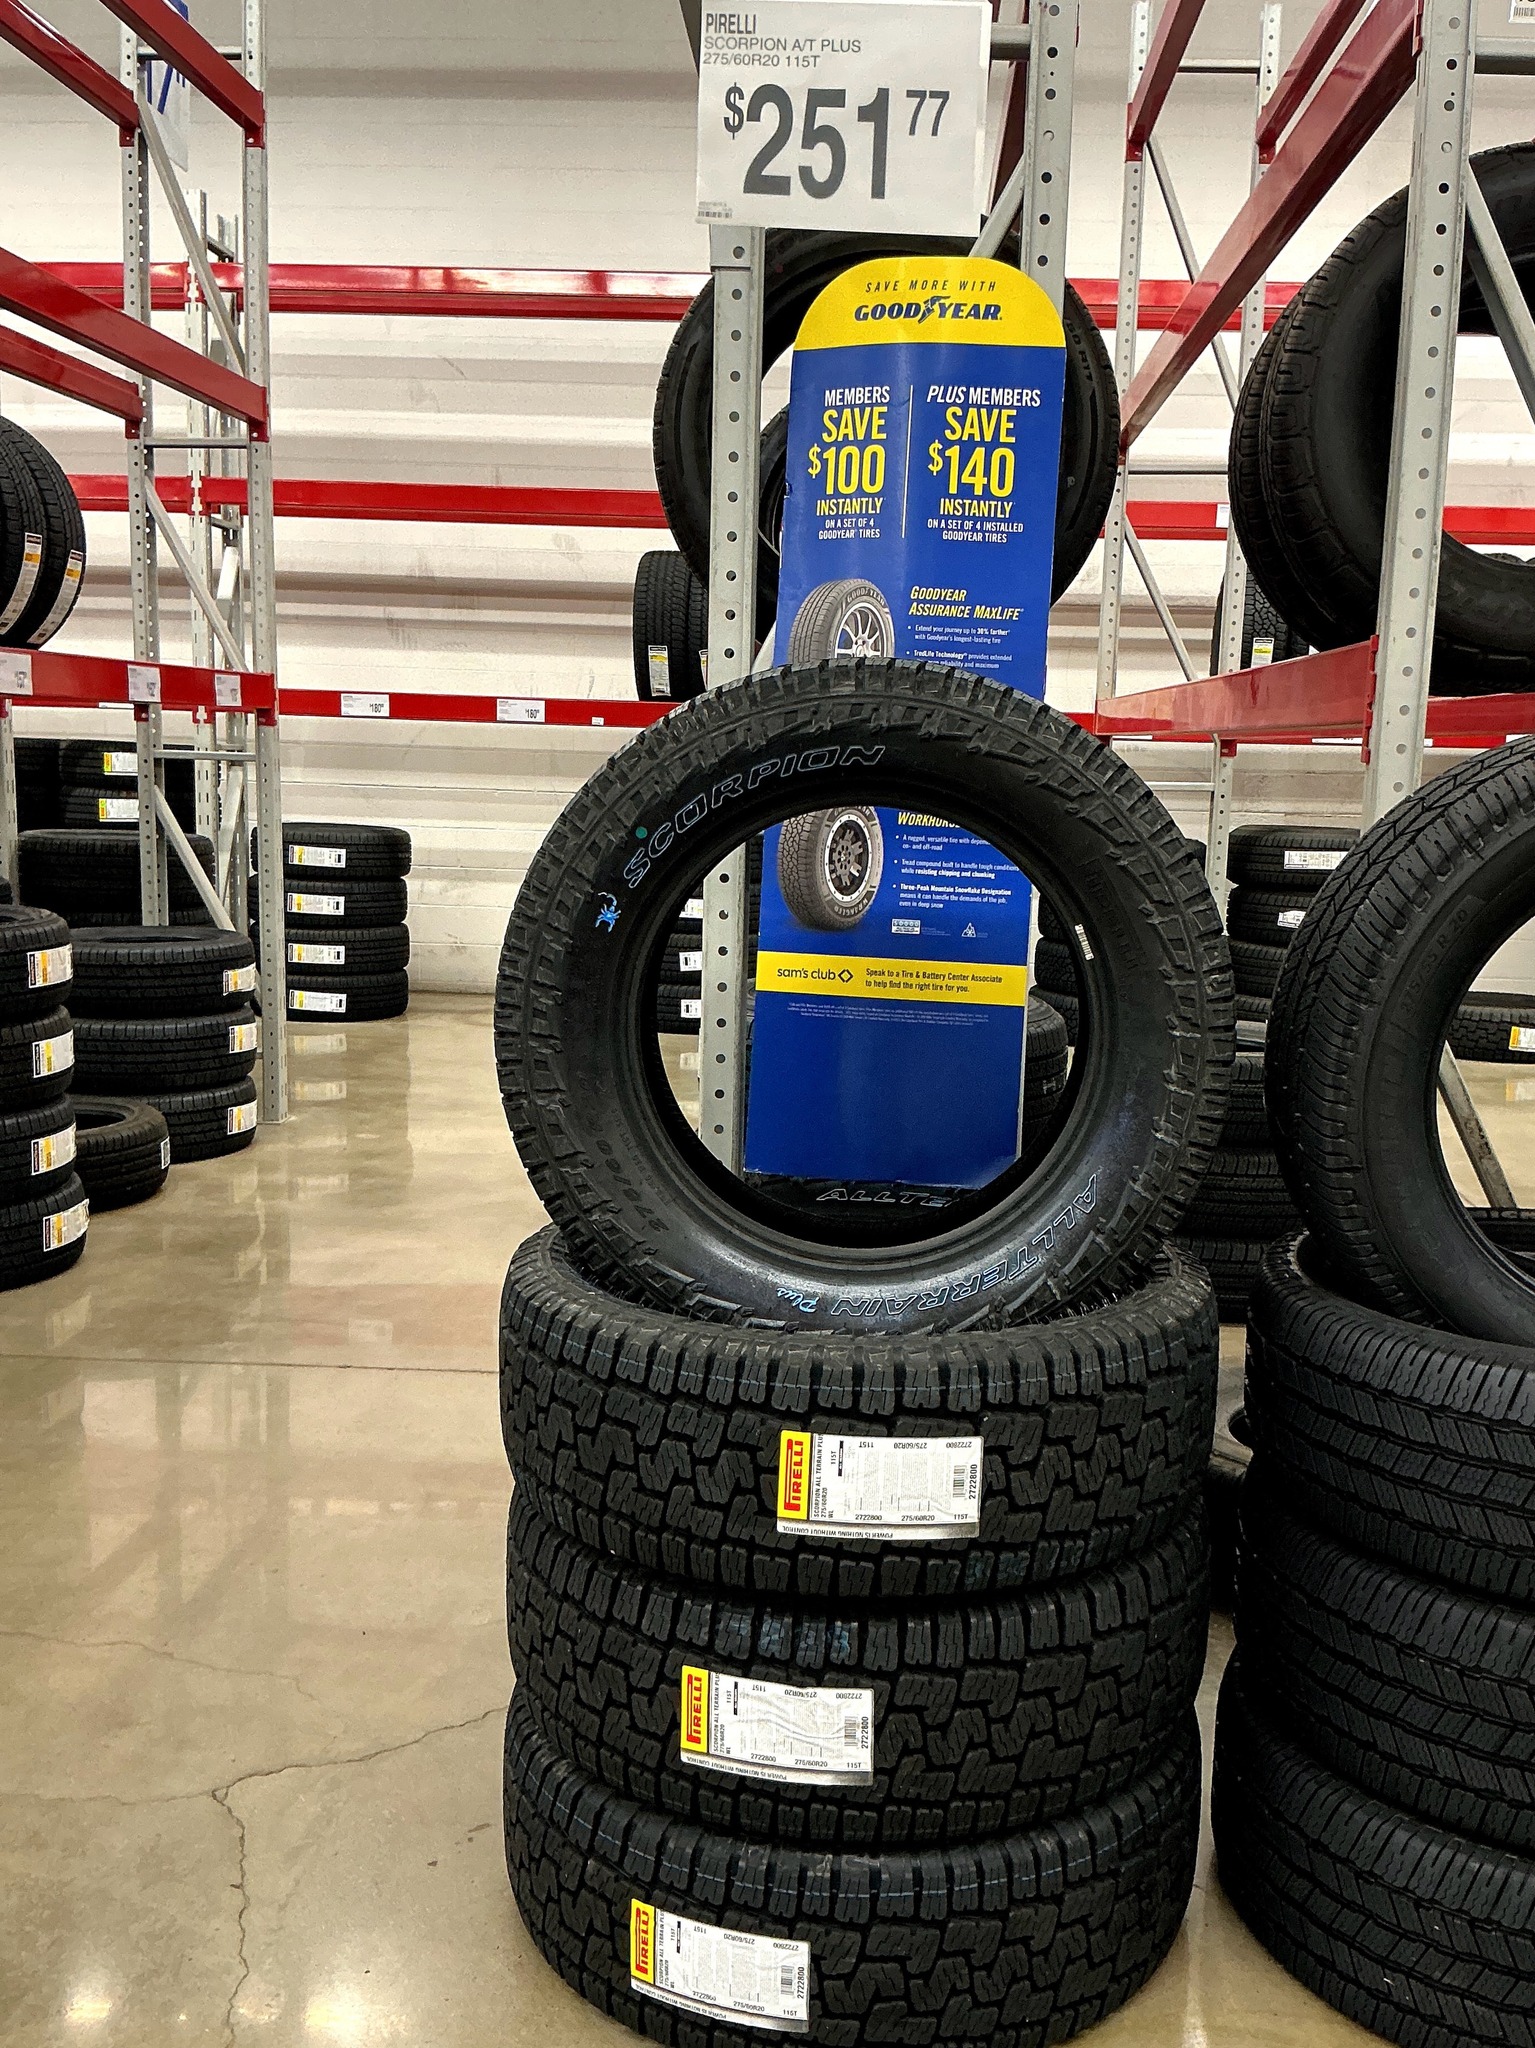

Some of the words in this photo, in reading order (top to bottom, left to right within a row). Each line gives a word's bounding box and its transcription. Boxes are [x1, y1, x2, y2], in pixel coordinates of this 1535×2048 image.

[706, 14, 756, 34] PIRELLI
[704, 37, 787, 51] SCORPION
[792, 39, 816, 52] A/T
[821, 39, 861, 52] PLUS
[703, 53, 780, 67] 275/60R20
[786, 54, 820, 68] 115T
[866, 281, 899, 293] SAVE
[909, 280, 948, 291] MORE
[959, 281, 996, 292] WITH
[854, 296, 1002, 324] GOODYEAR
[824, 386, 890, 407] MEMBERS
[927, 385, 966, 403] PLUS
[969, 387, 1041, 407] MEMBERS
[822, 407, 888, 443] SAVE
[944, 407, 1017, 443] SAVE
[808, 443, 886, 495] $100
[927, 440, 1015, 497] $140
[816, 497, 883, 516] INSTANTLY
[940, 498, 1013, 518] INSTANTLY
[825, 520, 835, 528] ON
[836, 519, 841, 528] A
[843, 519, 856, 527] SET
[858, 519, 868, 527] OF
[869, 518, 874, 526] 4
[927, 519, 938, 528] ON
[939, 519, 945, 528] A
[946, 520, 961, 529] SET
[963, 521, 973, 530] OF
[975, 521, 981, 531] 4
[983, 522, 1023, 533] INSTALLED
[819, 530, 855, 539] GOODYEAR
[859, 529, 880, 538] TIRES
[942, 531, 983, 542] GOODYEAR
[985, 533, 1007, 543] TIRES
[909, 603, 970, 618] ASSURANCE
[954, 635, 990, 644] longest-lasting
[623, 745, 886, 889] SCORPION
[972, 871, 995, 879] chunking
[901, 883, 929, 891] Three-Peak
[981, 887, 1011, 895] Designation
[777, 968, 808, 979] sam's
[811, 968, 836, 980] club
[866, 968, 886, 978] Speak
[887, 969, 894, 977] to
[902, 970, 914, 978] Tire
[916, 971, 920, 979] &
[922, 971, 946, 981] Battery
[948, 972, 969, 981] Center
[971, 974, 1003, 983] Associate
[865, 979, 872, 987] to
[873, 979, 888, 989] help
[889, 980, 901, 988] find
[903, 981, 913, 989] the
[915, 982, 931, 991] right
[932, 983, 943, 991] tire
[945, 983, 955, 991] for
[777, 1287, 820, 1313] Plus
[946, 1441, 972, 1449] 2722800
[784, 1439, 803, 1511] PIRELLI
[969, 1464, 978, 1500] 2722800
[783, 1526, 809, 1534] CONTROL
[811, 1528, 837, 1536] WITHOUT
[752, 1684, 766, 1692] 115T
[784, 1689, 817, 1698] 275/60R20
[687, 1674, 702, 1744] PIRELLI
[861, 1716, 869, 1749] 2722800
[751, 1753, 776, 1763] 2722800
[794, 1759, 828, 1768] 275/60R20
[636, 1907, 650, 1974] PIRELLI
[694, 1926, 706, 1934] 115T
[724, 1934, 755, 1944] 275/60R20
[797, 1967, 805, 1999] 2722800
[733, 2001, 765, 2012] 275/60R20
